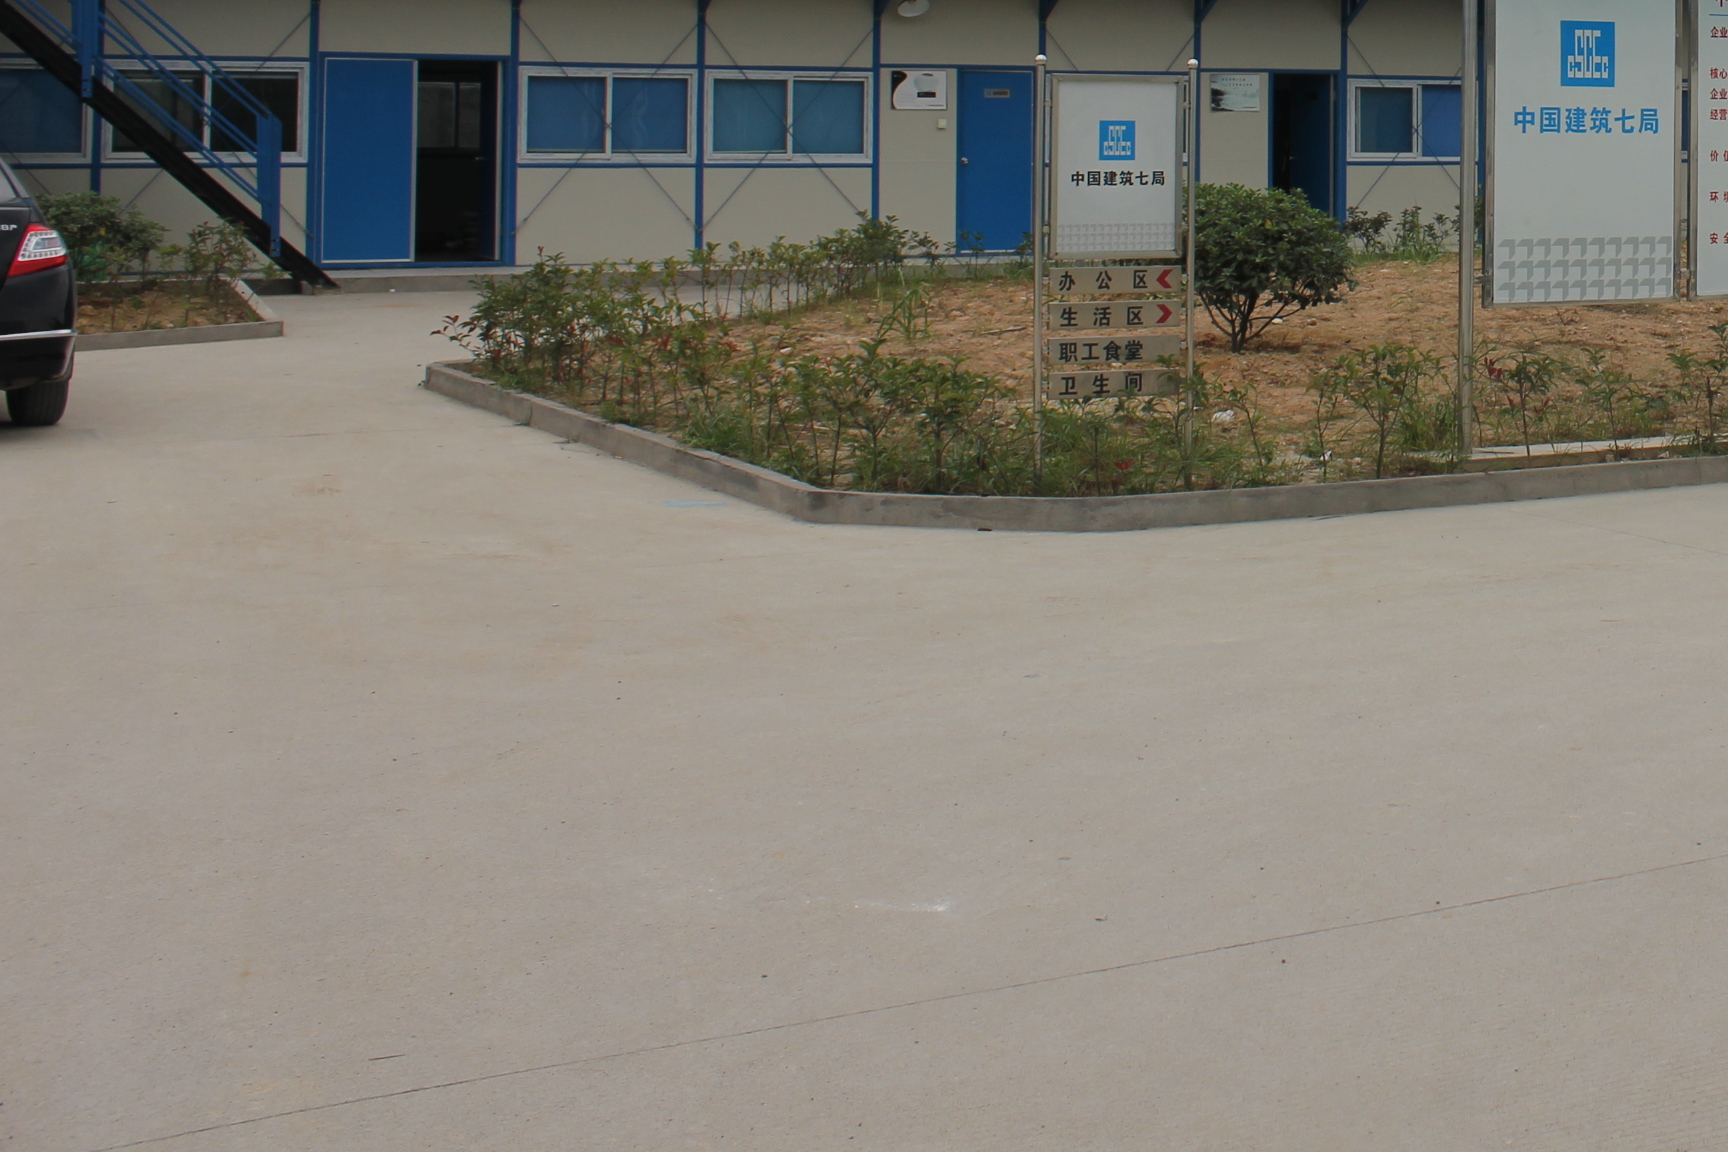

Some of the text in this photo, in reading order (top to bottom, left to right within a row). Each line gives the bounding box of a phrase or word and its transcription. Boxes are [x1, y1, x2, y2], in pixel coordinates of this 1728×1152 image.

[1513, 106, 1660, 134] 中国建筑七局
[1070, 170, 1165, 187] 中国建筑七局
[1058, 269, 1148, 291] 办公区
[1059, 306, 1144, 327] 生活区
[1058, 340, 1143, 363] 职工食堂
[1059, 372, 1143, 395] 卫生间
